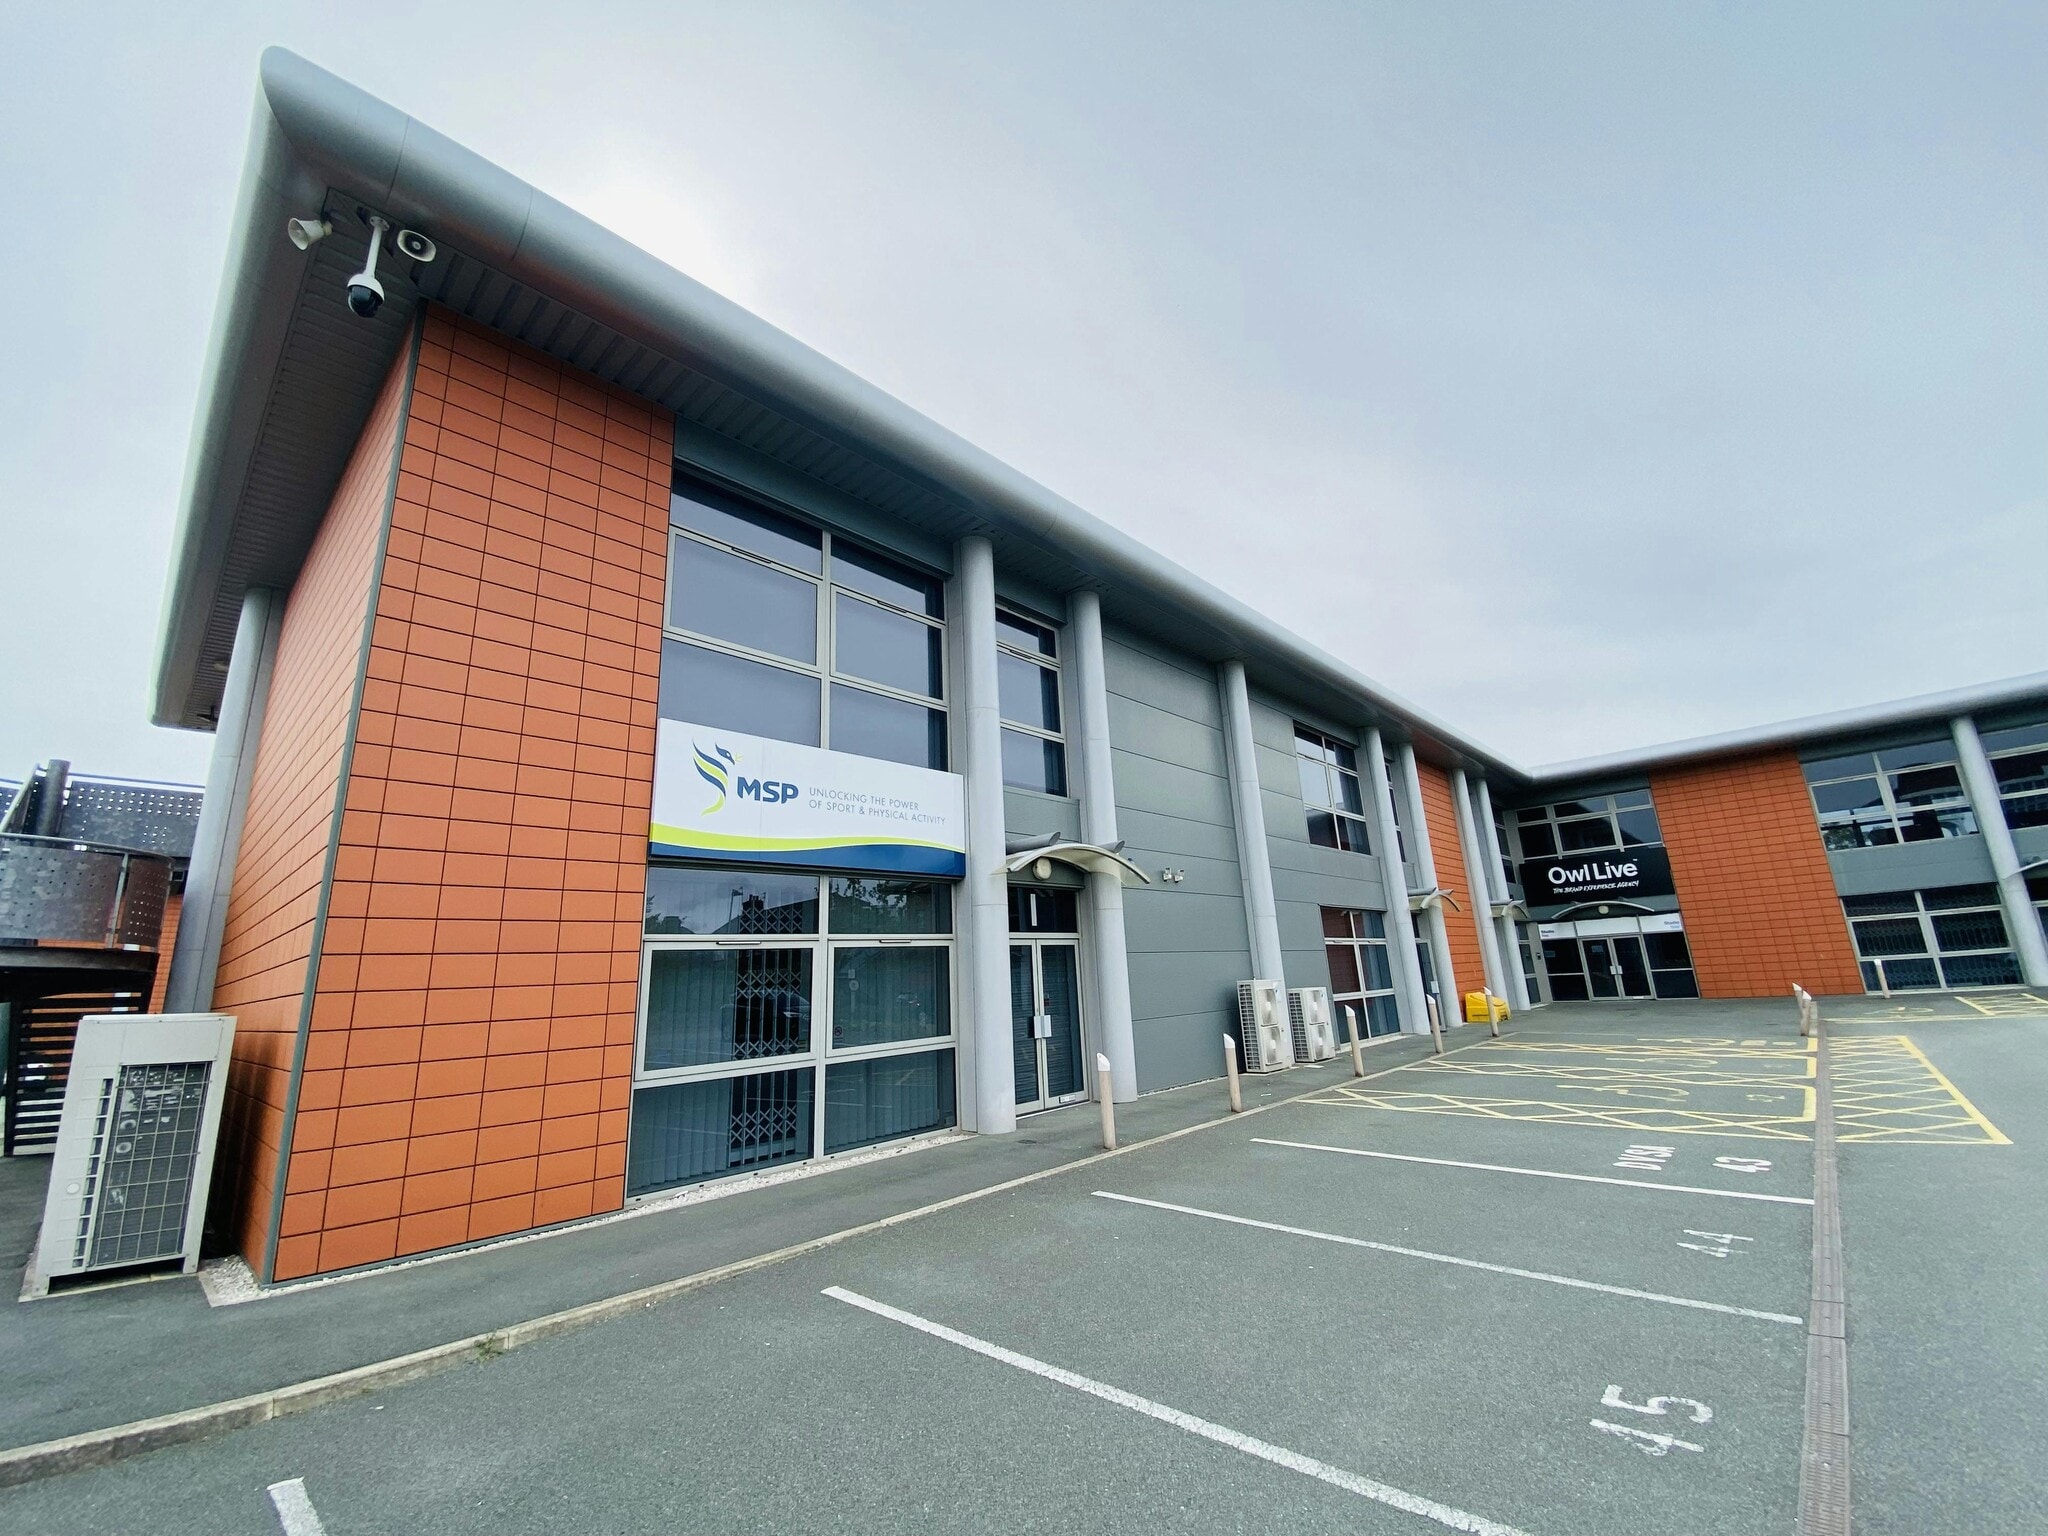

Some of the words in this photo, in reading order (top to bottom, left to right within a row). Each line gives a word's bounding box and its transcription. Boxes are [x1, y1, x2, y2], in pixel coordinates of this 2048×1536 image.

[737, 776, 799, 804] MSP
[809, 786, 867, 803] UNLOCKING
[871, 795, 886, 806] THE
[889, 798, 919, 811] POWER
[808, 799, 822, 809] OF
[826, 801, 855, 814] SPORT
[858, 805, 865, 815] &
[868, 807, 908, 821] PHYSICAL
[911, 813, 946, 825] ACTIVITY
[1548, 863, 1591, 885] Owl
[1592, 861, 1639, 880] Live
[1616, 880, 1640, 889] AGENCY
[1612, 1144, 1676, 1171] DVSA
[1711, 1156, 1772, 1173] 43
[1676, 1229, 1754, 1258] 44
[1589, 1384, 1714, 1457] 45
